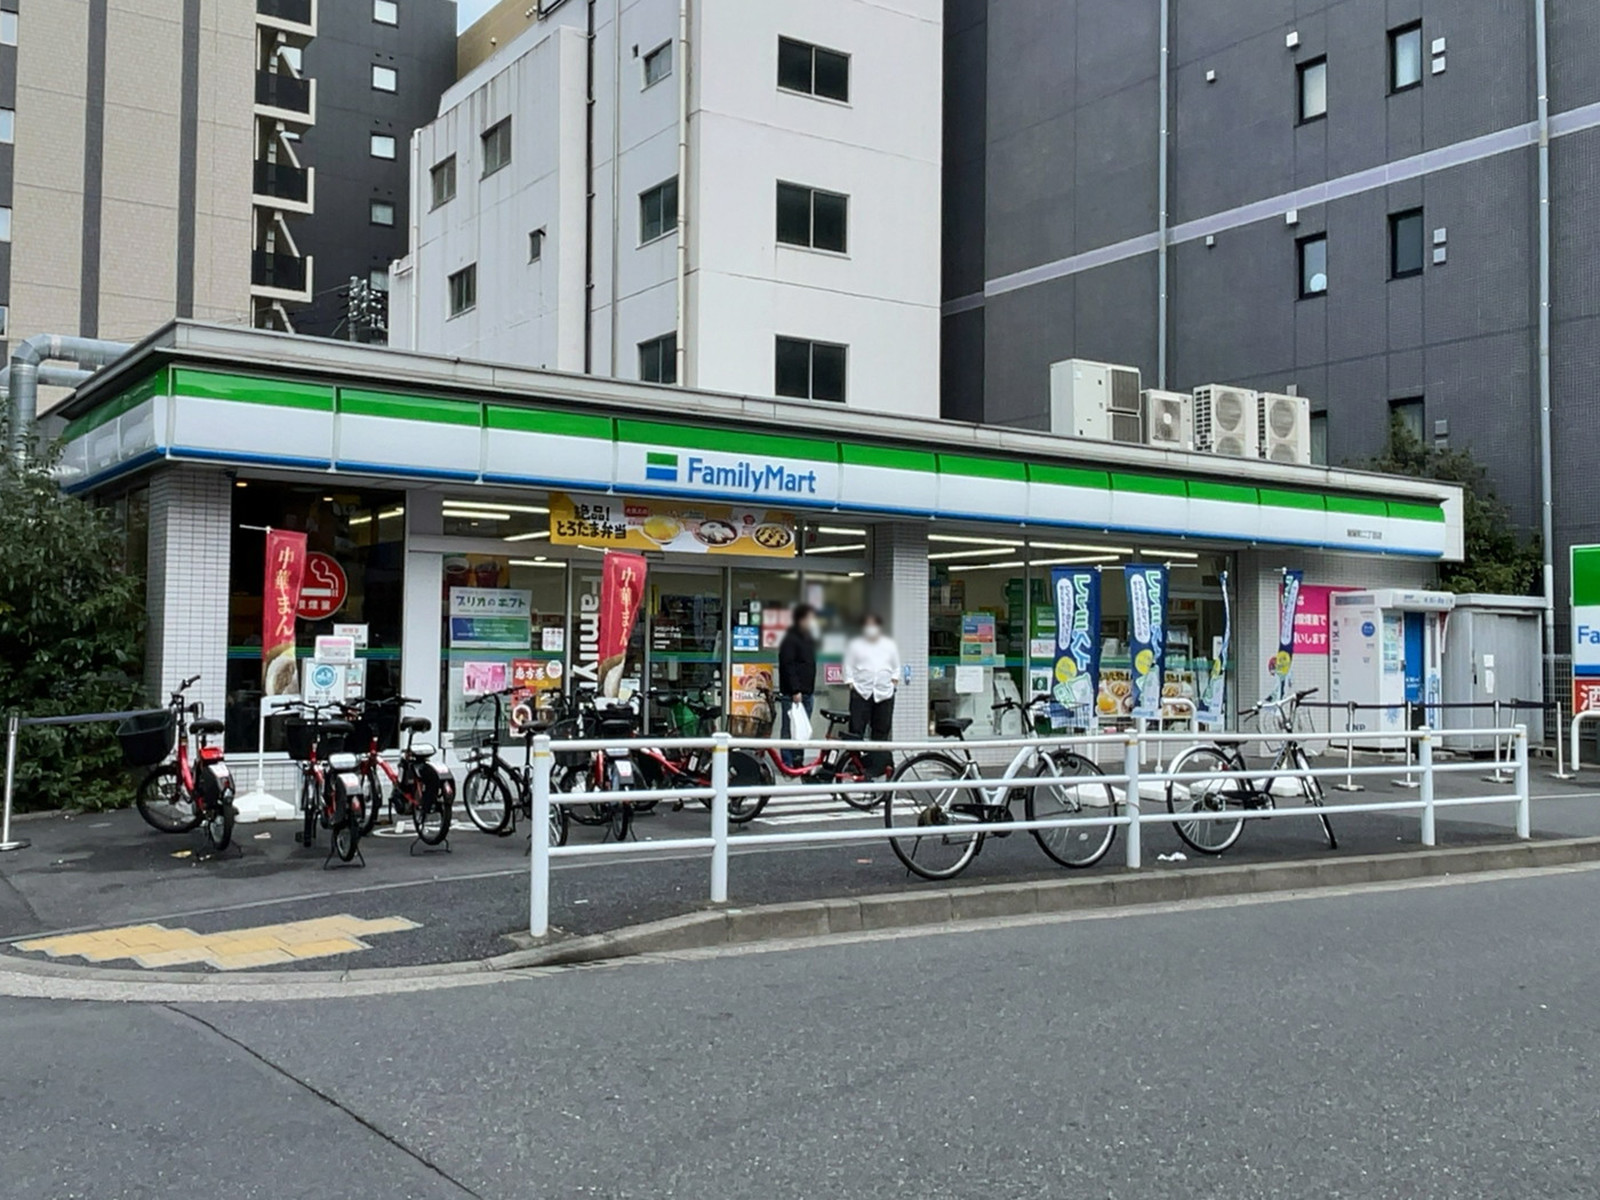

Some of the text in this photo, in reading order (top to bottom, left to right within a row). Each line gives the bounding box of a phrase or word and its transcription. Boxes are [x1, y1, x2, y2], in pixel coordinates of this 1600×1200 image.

[687, 457, 816, 493] FamilyMart
[557, 520, 627, 539] とろたま弁当
[275, 546, 295, 637] 中華まん
[619, 566, 636, 647] 中華まん
